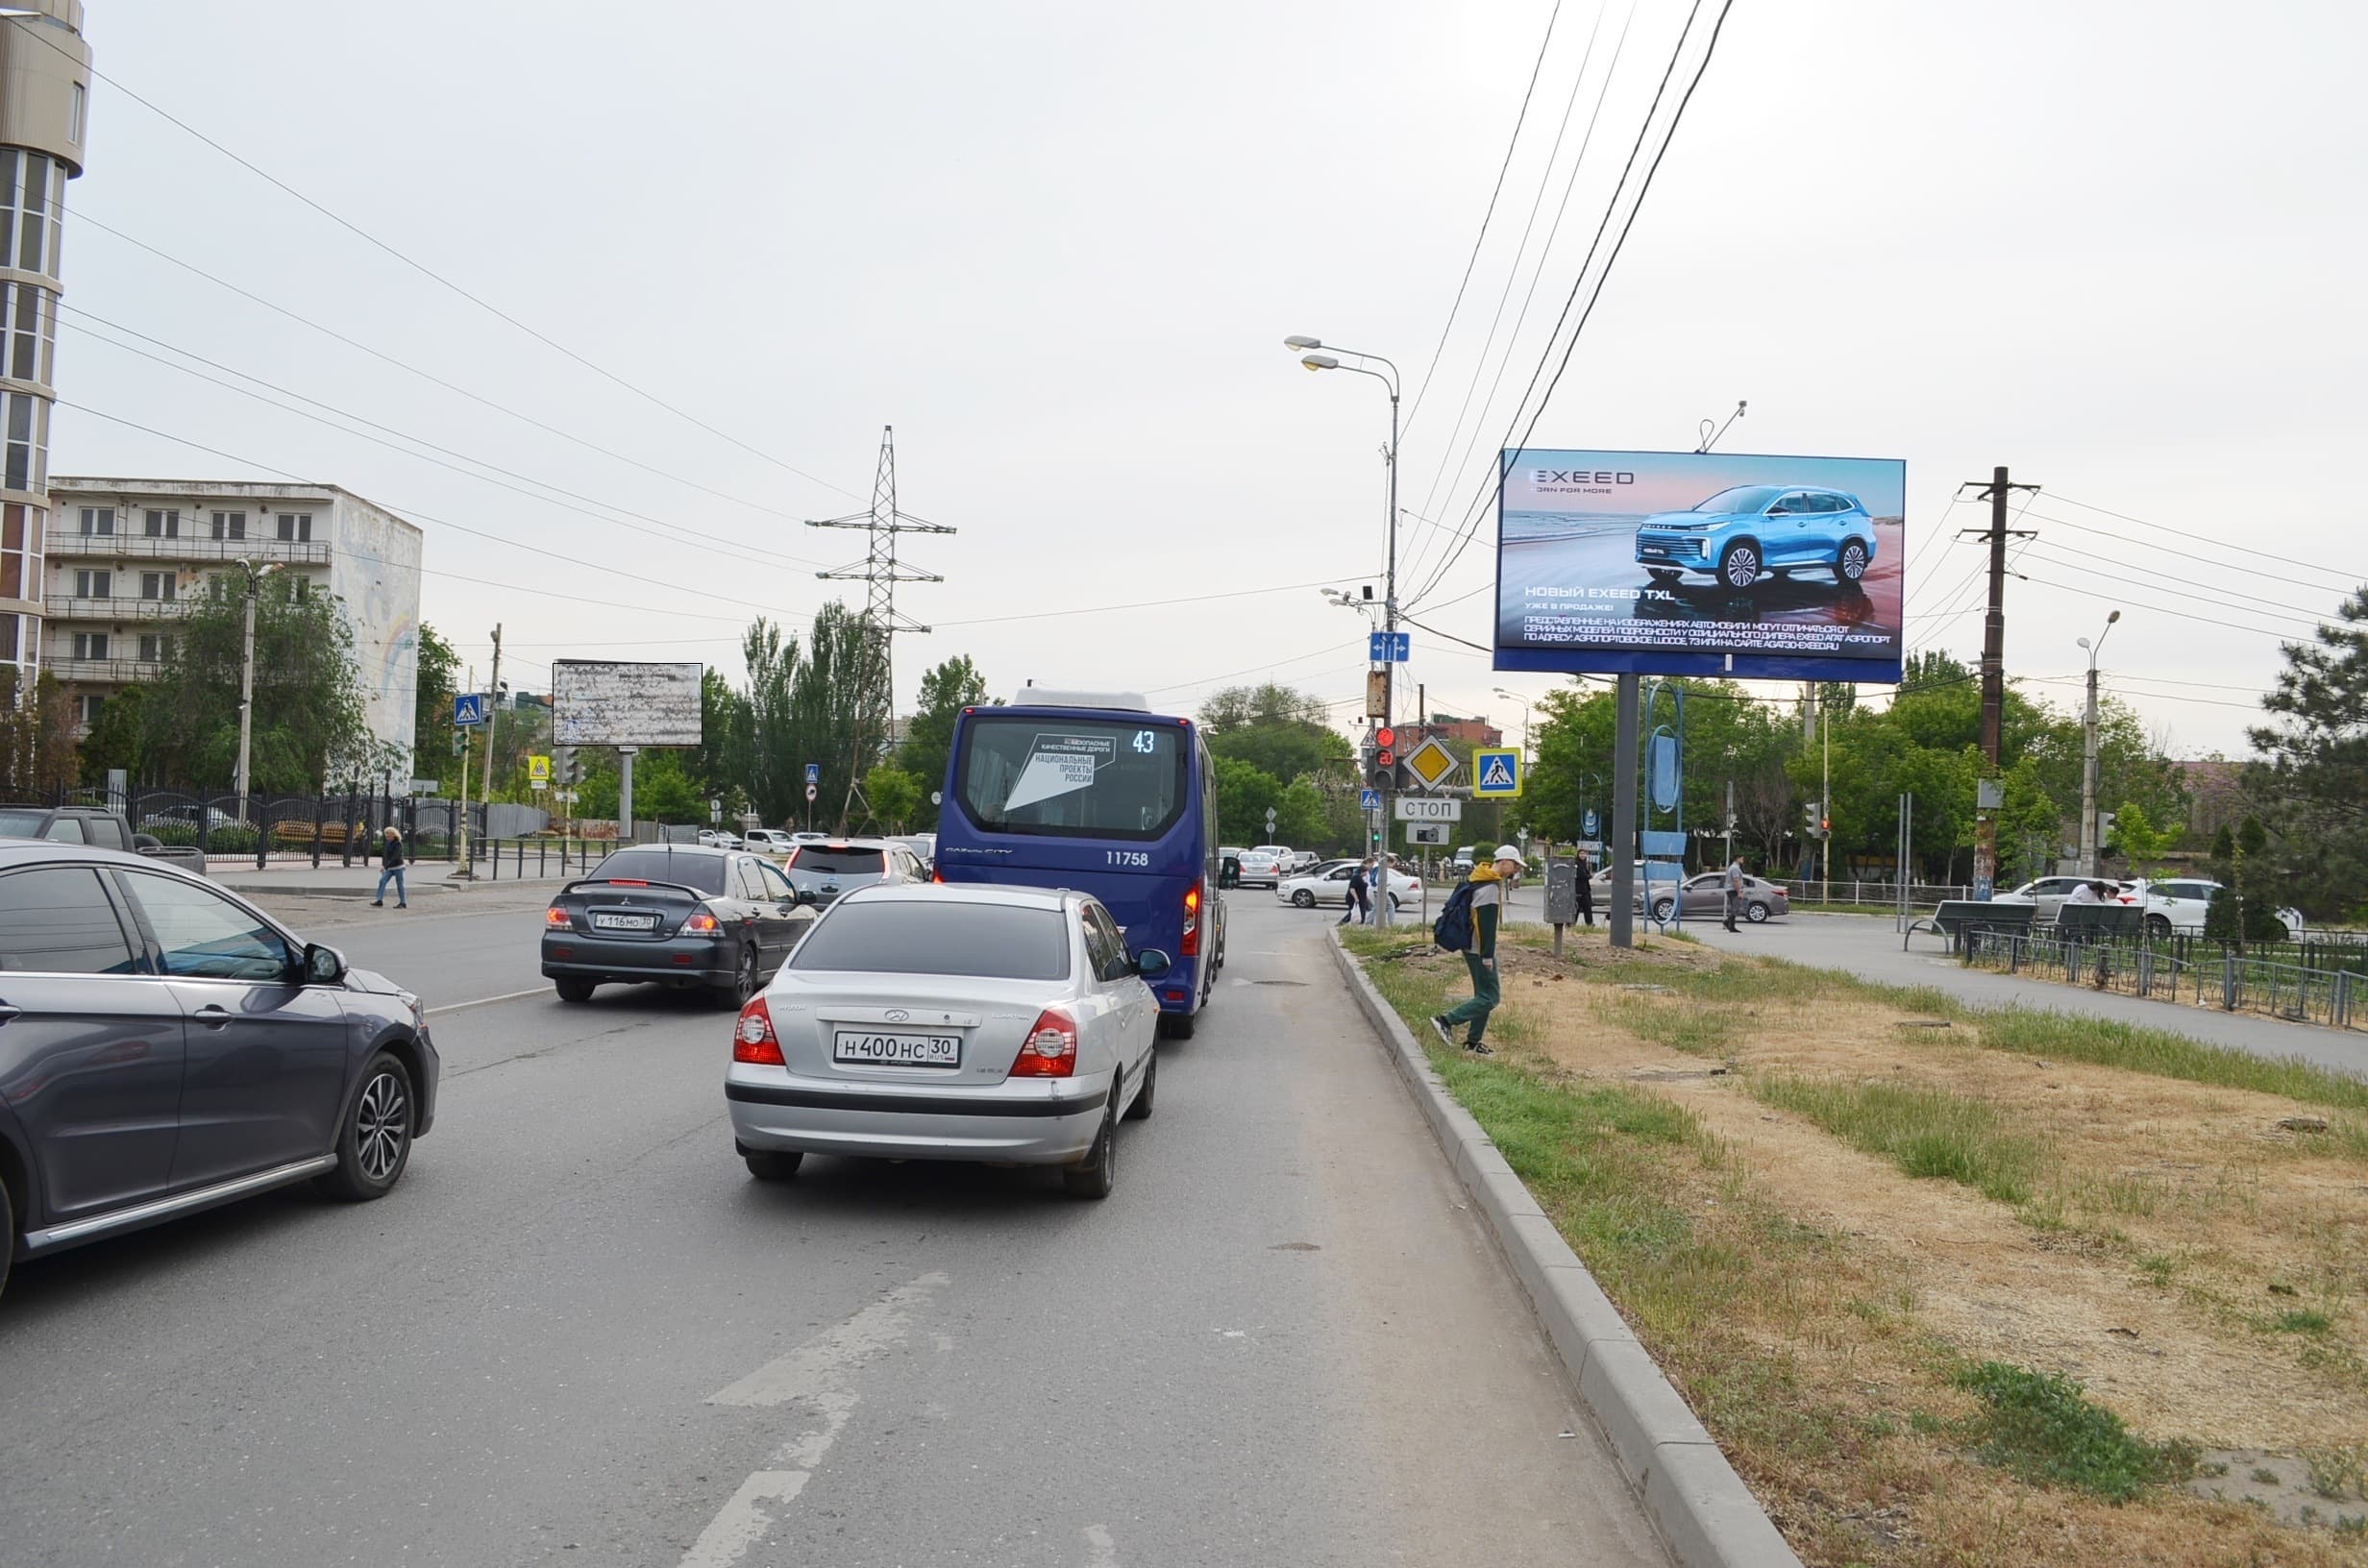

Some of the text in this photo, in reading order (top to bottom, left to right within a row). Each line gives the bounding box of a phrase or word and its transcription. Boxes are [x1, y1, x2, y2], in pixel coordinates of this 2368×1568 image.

[1530, 470, 1634, 484] EXEED
[1525, 586, 1675, 600] НОВЫЙ EXEED TXL
[1133, 731, 1154, 753] 43
[1036, 754, 1092, 766] НАЦИОНАЛЬНЫЕ
[1060, 764, 1093, 774] ПРОЕКТЫ
[1065, 773, 1093, 783] РОССИИ
[1406, 802, 1451, 817] СТОП
[1107, 851, 1149, 866] 11758
[930, 1039, 951, 1055] 30
